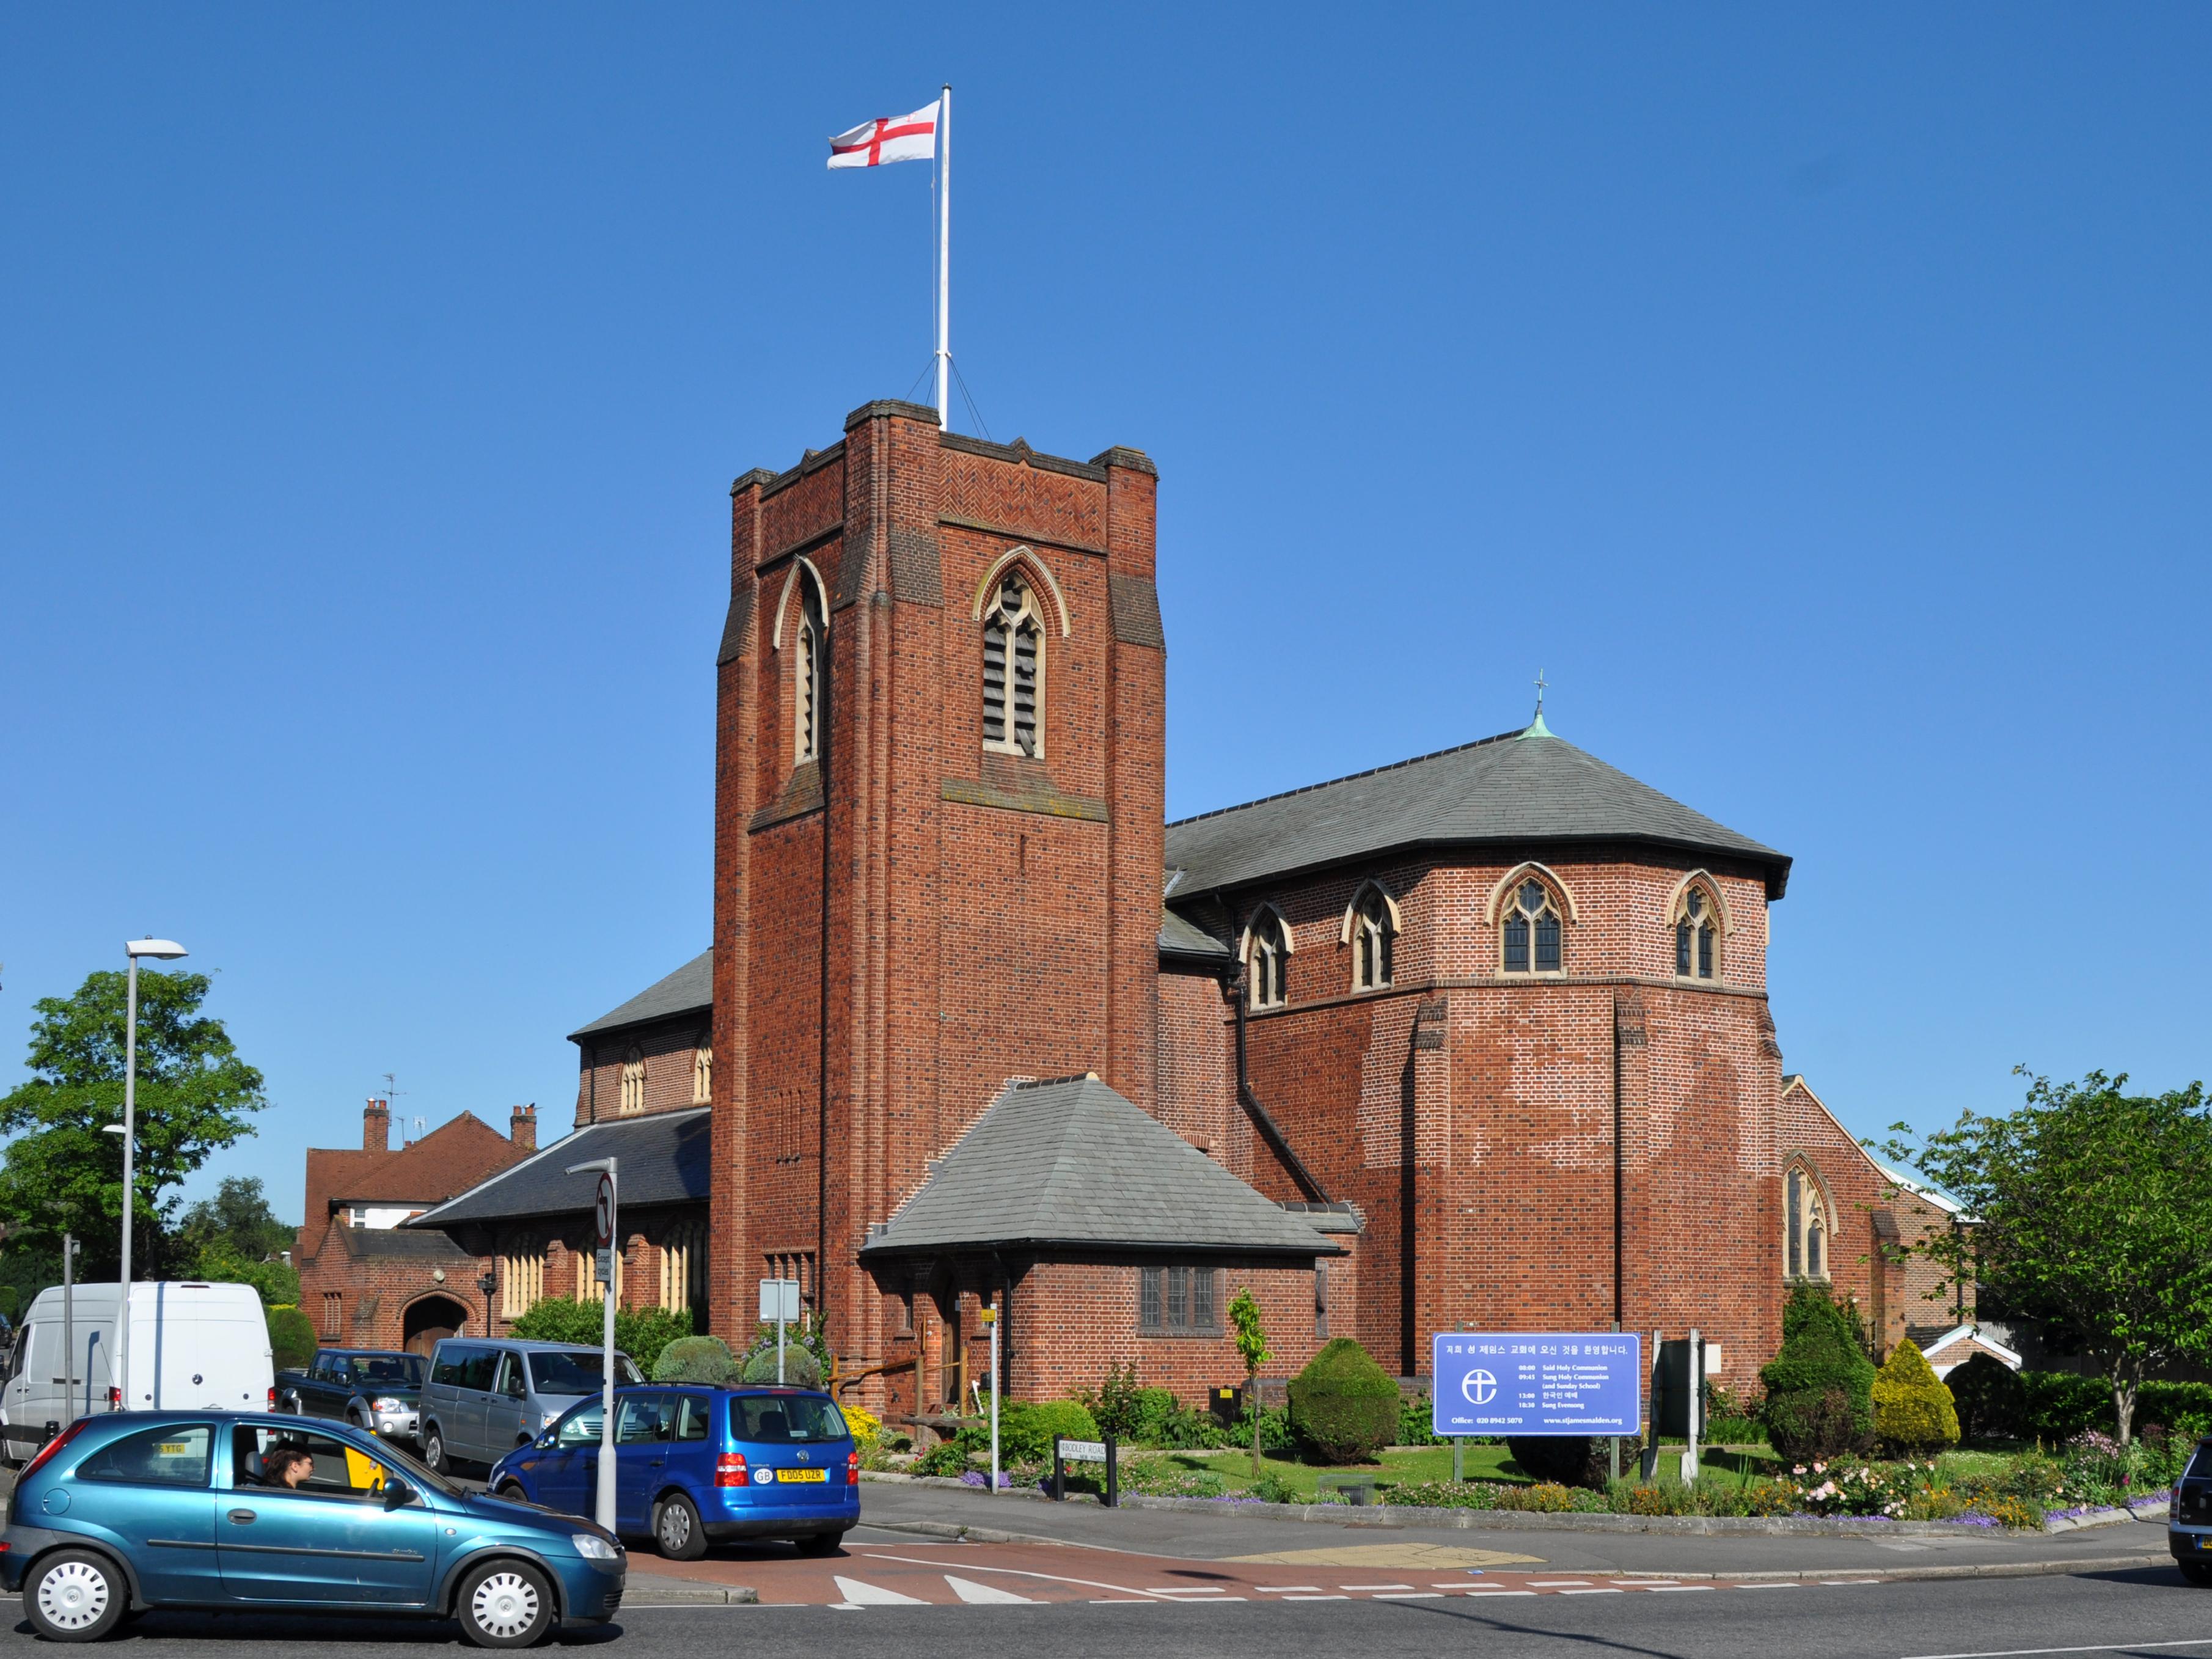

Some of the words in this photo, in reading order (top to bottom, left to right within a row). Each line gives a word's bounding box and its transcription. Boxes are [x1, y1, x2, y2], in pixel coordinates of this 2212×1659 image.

[598, 1253, 610, 1263] Except
[1446, 1345, 1462, 1354] 저희
[1468, 1344, 1476, 1354] 성
[1479, 1345, 1506, 1355] 제임스
[1511, 1345, 1536, 1355] 교회에
[1540, 1345, 1557, 1355] 오신
[1562, 1345, 1578, 1355] 것을
[1584, 1345, 1628, 1355] 환영합니다.
[1065, 1443, 1086, 1453] BODLEY
[1088, 1445, 1106, 1454] ROAD
[756, 1471, 771, 1481] GB
[805, 1471, 821, 1479] UZR
